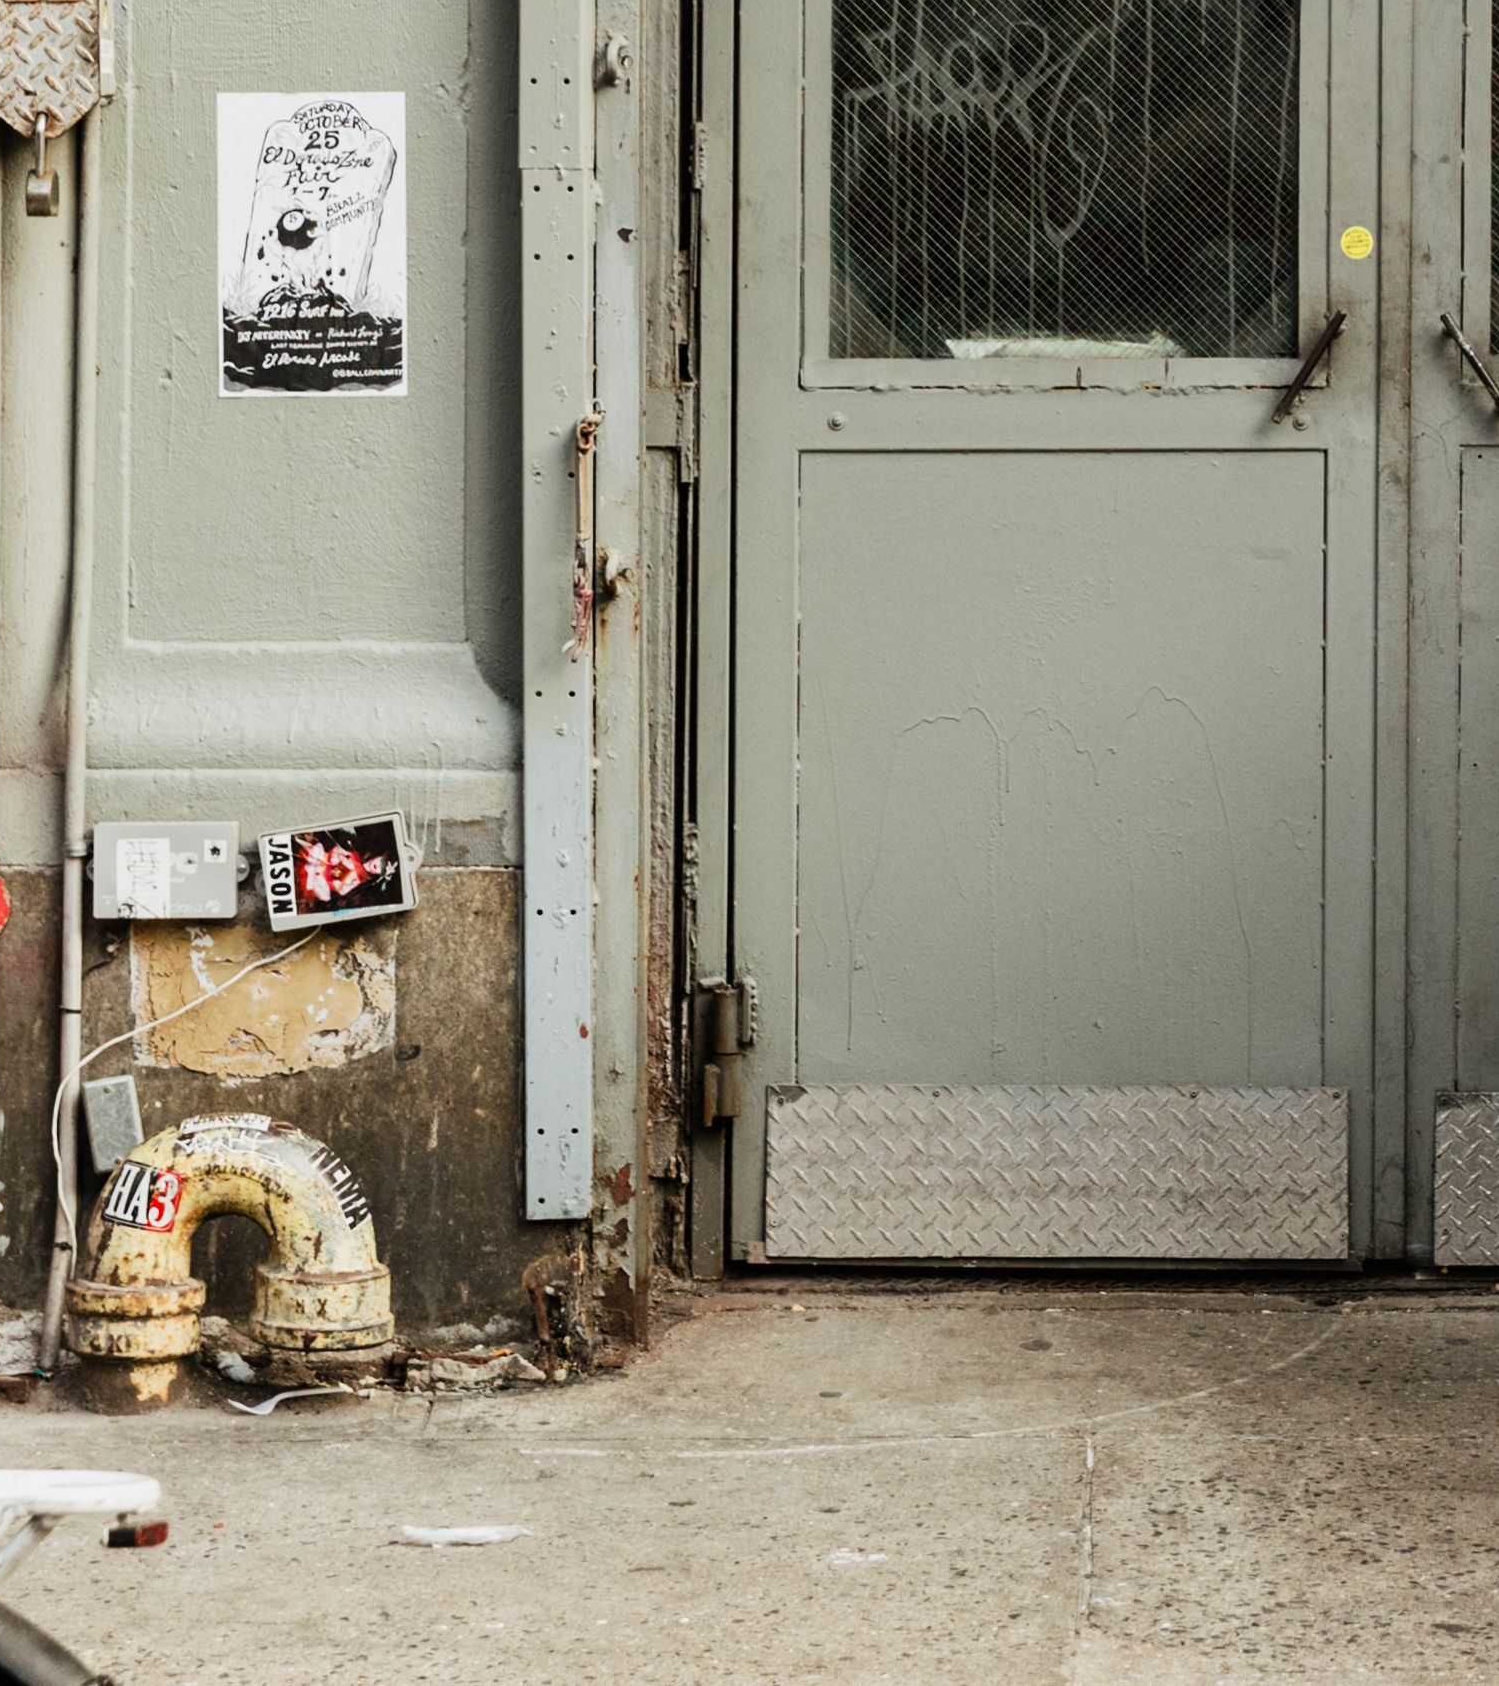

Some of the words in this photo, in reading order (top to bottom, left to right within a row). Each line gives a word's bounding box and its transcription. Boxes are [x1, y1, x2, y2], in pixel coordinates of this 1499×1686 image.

[293, 102, 353, 125] SATURDAY
[299, 115, 363, 134] OCTOBER
[304, 130, 341, 152] 25
[283, 165, 345, 189] Fair
[267, 835, 294, 916] JASON
[105, 1162, 181, 1229] HA3
